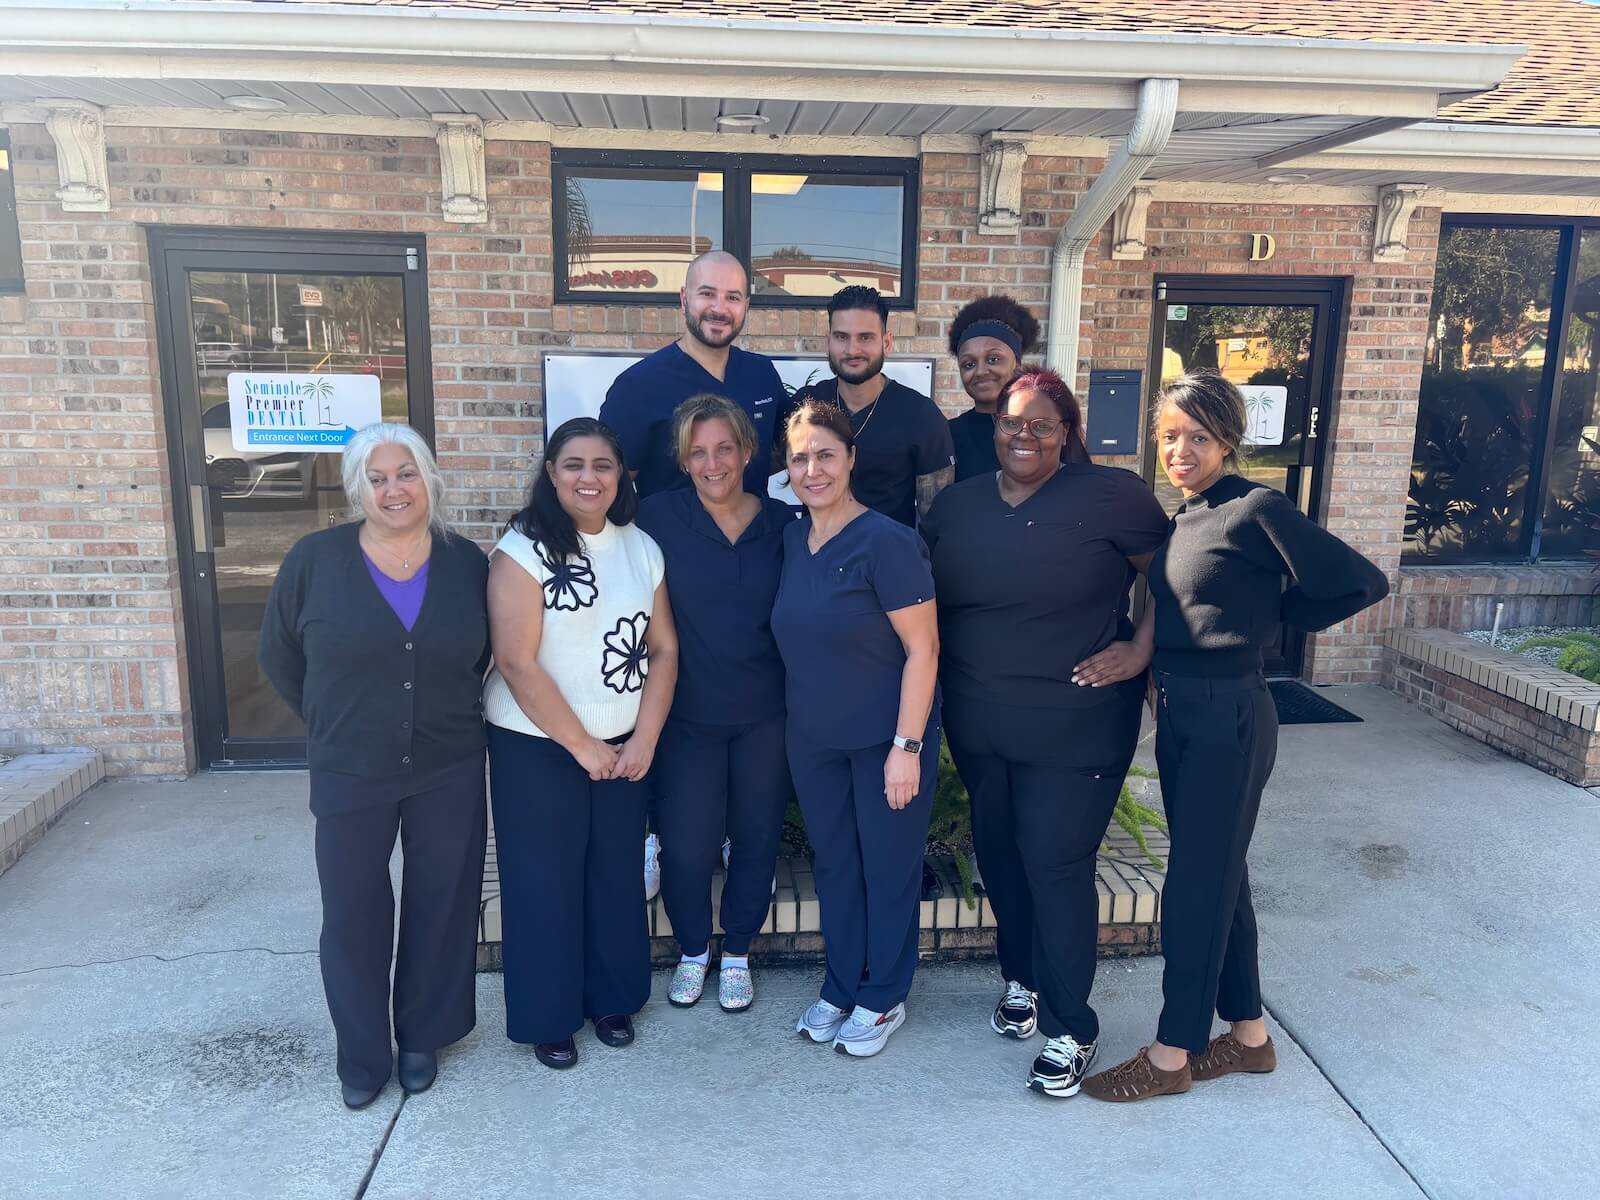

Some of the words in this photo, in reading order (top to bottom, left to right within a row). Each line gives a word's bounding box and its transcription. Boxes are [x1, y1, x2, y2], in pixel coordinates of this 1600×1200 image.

[1250, 233, 1276, 261] D
[245, 380, 302, 395] Seminole
[246, 395, 303, 410] Premier
[248, 411, 306, 425] DENTAL
[253, 432, 295, 441] Entrance
[296, 432, 318, 441] Next
[320, 433, 344, 442] Door
